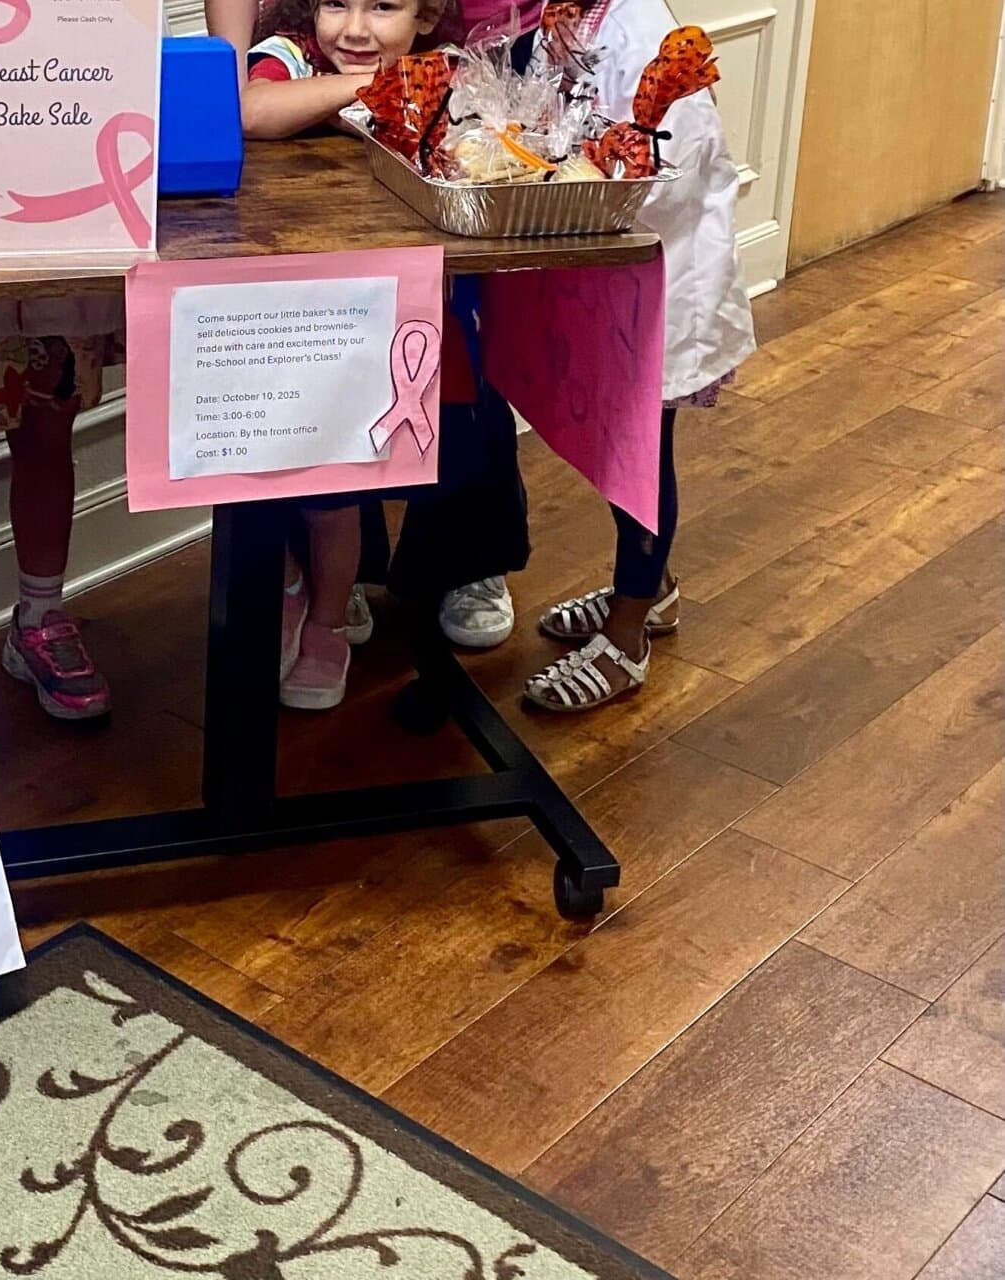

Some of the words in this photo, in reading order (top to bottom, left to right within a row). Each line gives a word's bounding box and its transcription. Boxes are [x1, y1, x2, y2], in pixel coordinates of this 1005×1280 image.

[97, 16, 114, 24] Only
[43, 57, 113, 83] Cancer
[48, 101, 93, 126] Sale
[197, 315, 225, 325] Come
[226, 312, 262, 323] support
[263, 311, 279, 320] our
[280, 310, 301, 320] little
[302, 307, 334, 318] baker's
[336, 308, 347, 316] as
[349, 306, 369, 317] they
[197, 329, 213, 339] sell
[215, 327, 256, 338] delicious
[257, 324, 293, 335] cookies
[294, 323, 311, 333] and
[196, 344, 222, 354] made
[224, 342, 244, 352] with
[245, 342, 266, 351] care
[267, 340, 284, 349] and
[286, 337, 336, 348] excitement
[337, 336, 348, 347] by
[350, 336, 365, 345] our
[196, 356, 246, 369] Pre-School
[248, 356, 266, 366] and
[267, 353, 312, 365] Explorer's
[313, 351, 342, 362] Class!
[196, 395, 221, 404] Date:
[222, 393, 260, 403] October
[262, 391, 275, 401] 10,
[277, 390, 300, 400] 2025
[195, 412, 220, 422] Time:
[222, 410, 266, 421] 3:00-6:00
[196, 430, 238, 441] Location:
[240, 428, 251, 439] By
[253, 427, 268, 437] the
[270, 426, 291, 437] front
[292, 424, 318, 435] office
[196, 449, 220, 459] Cost:
[221, 446, 248, 457] $1.00
